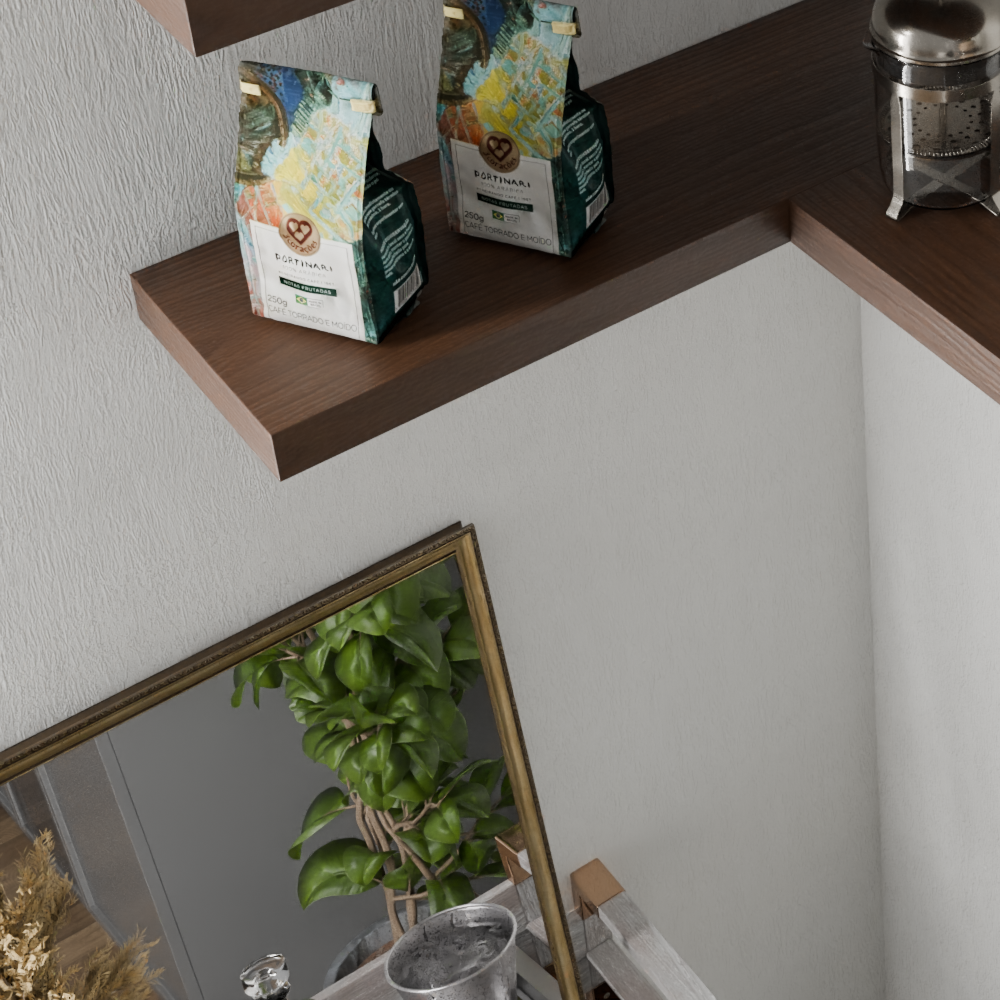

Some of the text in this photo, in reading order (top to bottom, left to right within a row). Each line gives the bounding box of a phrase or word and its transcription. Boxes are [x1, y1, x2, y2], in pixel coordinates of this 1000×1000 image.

[474, 169, 531, 189] PORTINARI
[464, 210, 484, 223] 250g
[484, 225, 519, 240] TORRADO
[274, 252, 333, 272] PORTINARI
[267, 294, 288, 308] 250g
[288, 310, 324, 325] TORRADO
[325, 319, 330, 327] E
